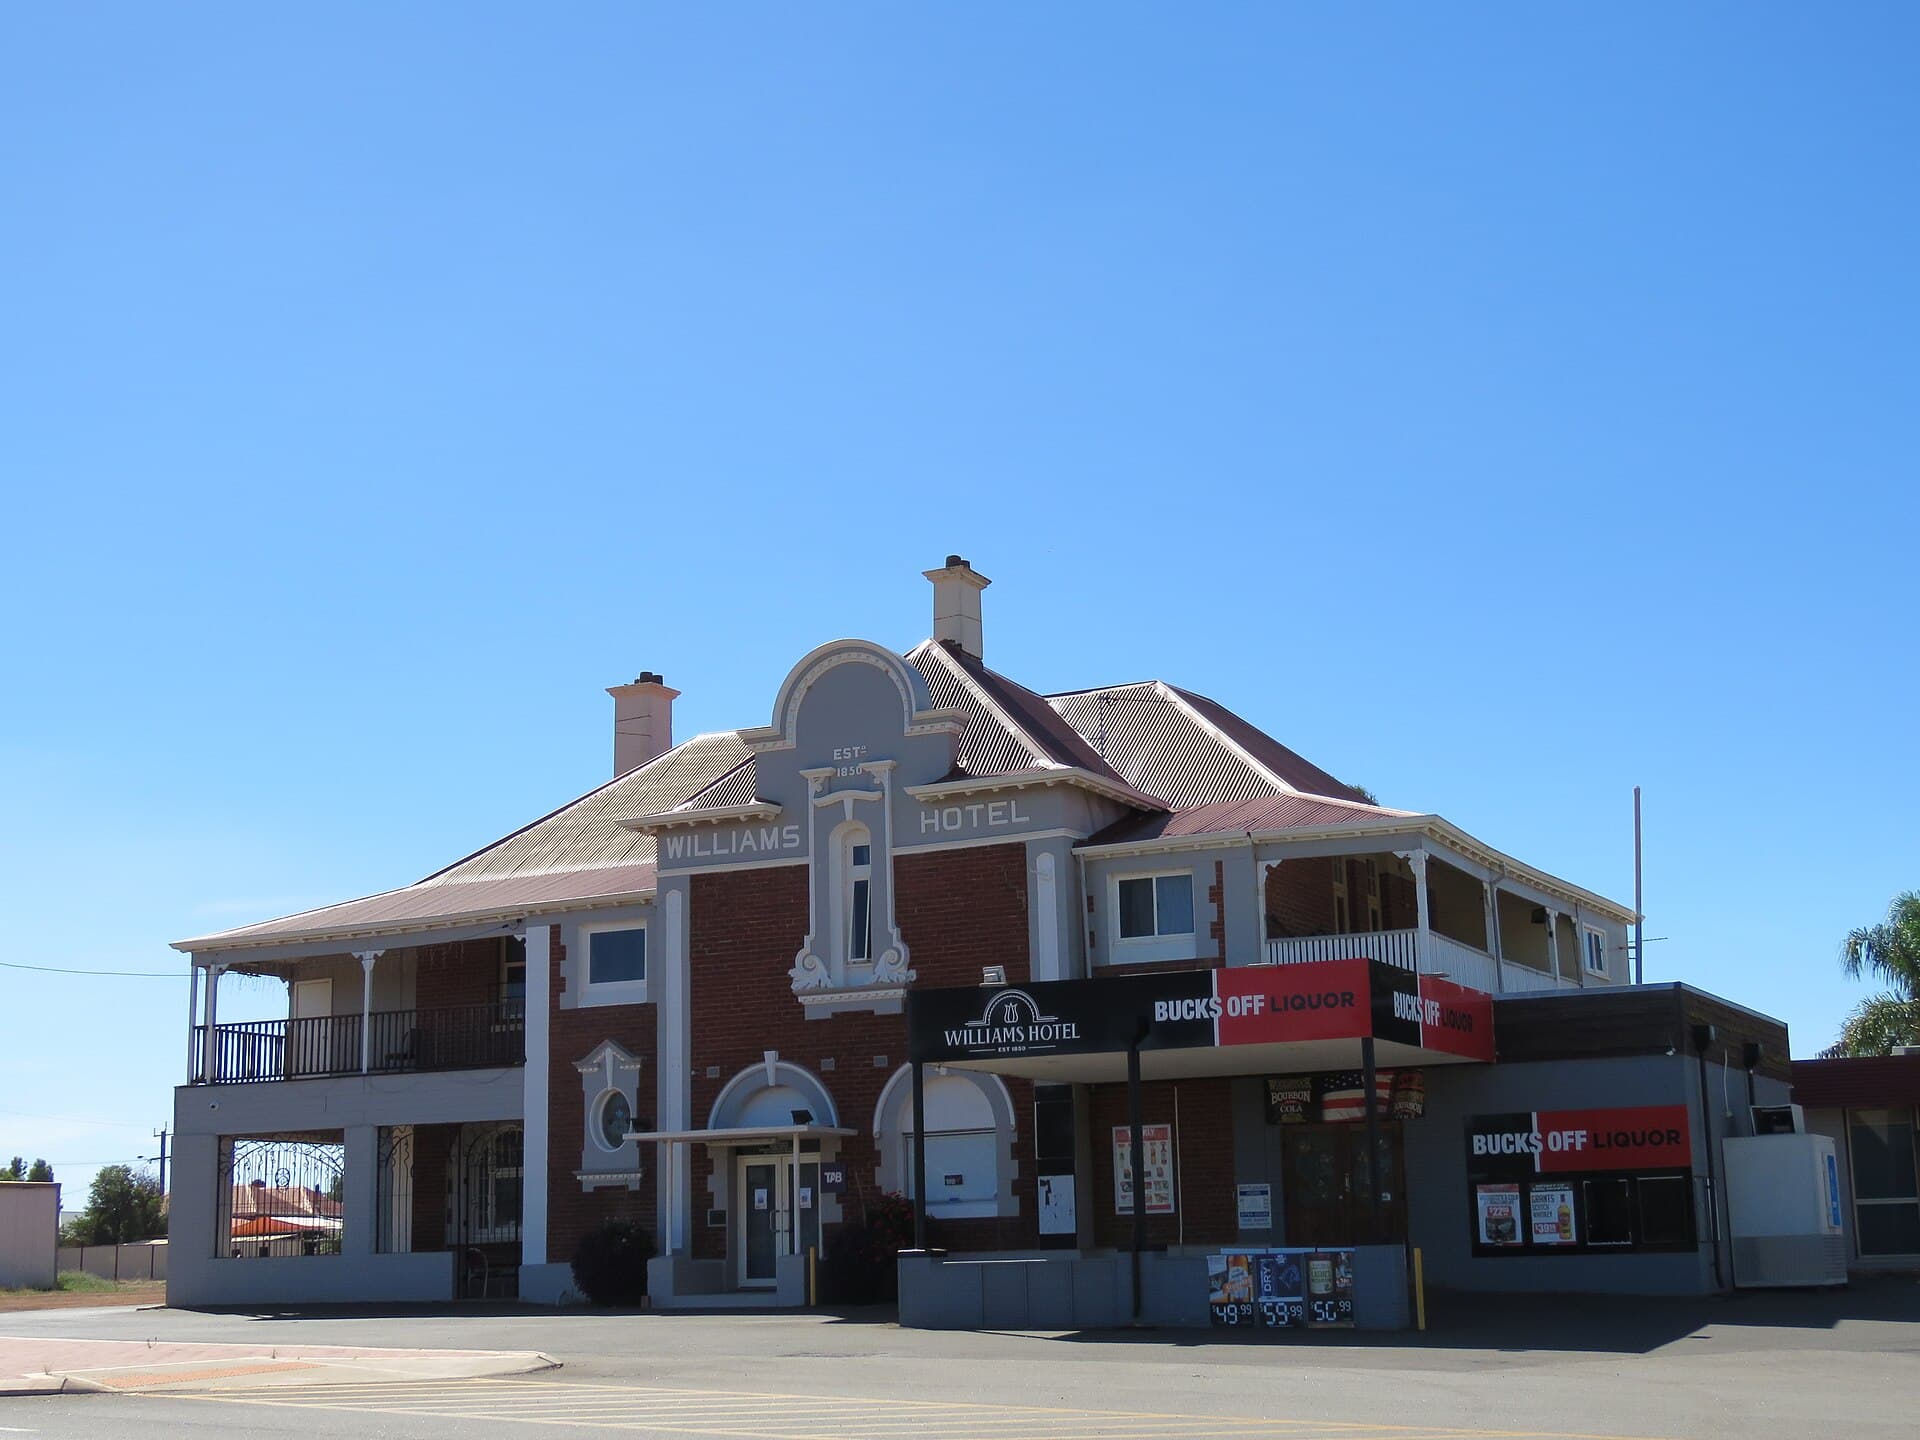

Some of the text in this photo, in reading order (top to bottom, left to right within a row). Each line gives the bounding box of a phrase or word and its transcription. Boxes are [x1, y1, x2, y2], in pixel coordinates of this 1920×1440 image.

[837, 766, 863, 777] 1850
[920, 799, 1030, 833] HOTEL
[666, 825, 800, 859] WILLIAMS
[1154, 991, 1355, 1022] BUCKS OFF LIQUOR
[1393, 991, 1473, 1032] BUCKS OFF LIQUOR
[944, 1023, 1081, 1047] WILLIAMS HOTEL
[1271, 1090, 1311, 1105] BOURBON
[1280, 1104, 1303, 1113] COLA
[1472, 1129, 1681, 1155] BUCKS OFF LIQUOR
[824, 1171, 842, 1184] TAB
[1263, 1266, 1272, 1292] DRY
